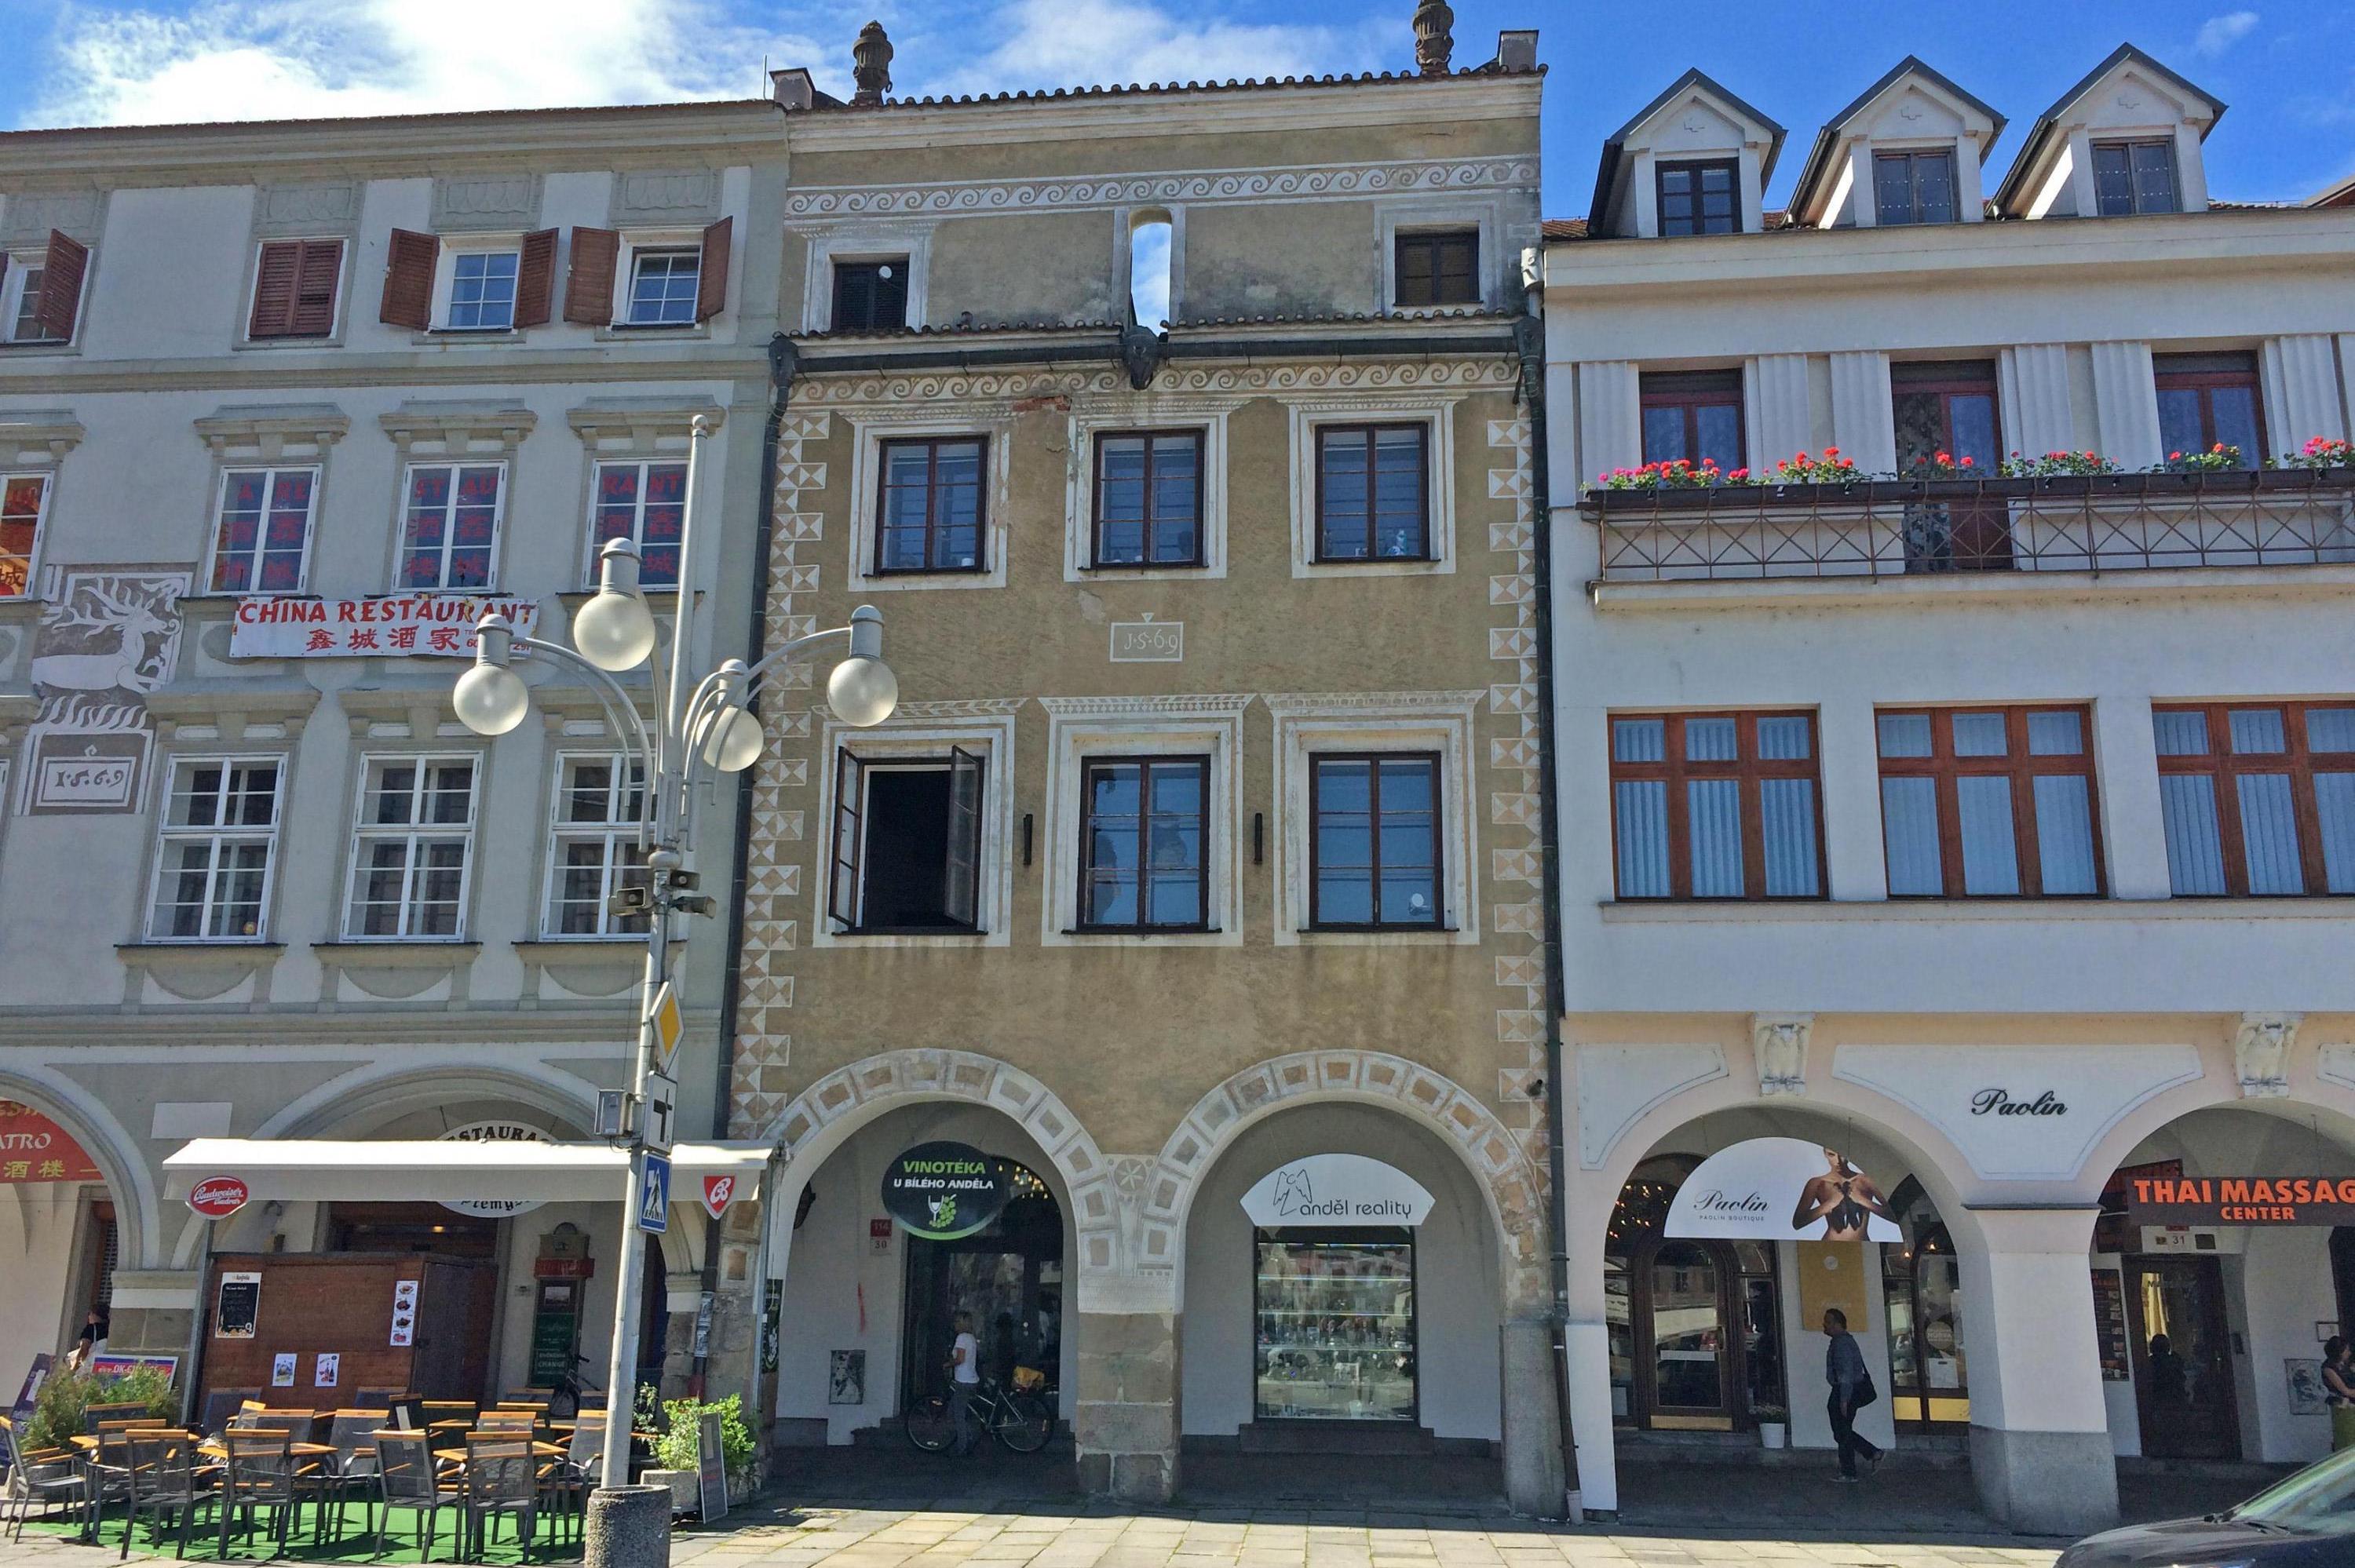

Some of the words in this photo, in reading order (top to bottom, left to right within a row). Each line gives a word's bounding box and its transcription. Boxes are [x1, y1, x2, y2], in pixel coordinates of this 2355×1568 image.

[239, 601, 327, 624] CHINA
[338, 600, 537, 625] RESTAURANT
[1971, 1088, 2068, 1115] Paolin
[904, 1158, 986, 1175] VINOTÉKA
[893, 1178, 902, 1187] U
[904, 1177, 946, 1189] BÍLÉHO
[2134, 1180, 2212, 1203] THAI
[1300, 1199, 1349, 1216] anděl
[1356, 1200, 1411, 1219] reality
[1693, 1189, 1771, 1212] Paolin
[2221, 1206, 2296, 1220] CENTER
[874, 1240, 887, 1249] 30
[2172, 1235, 2185, 1245] 31
